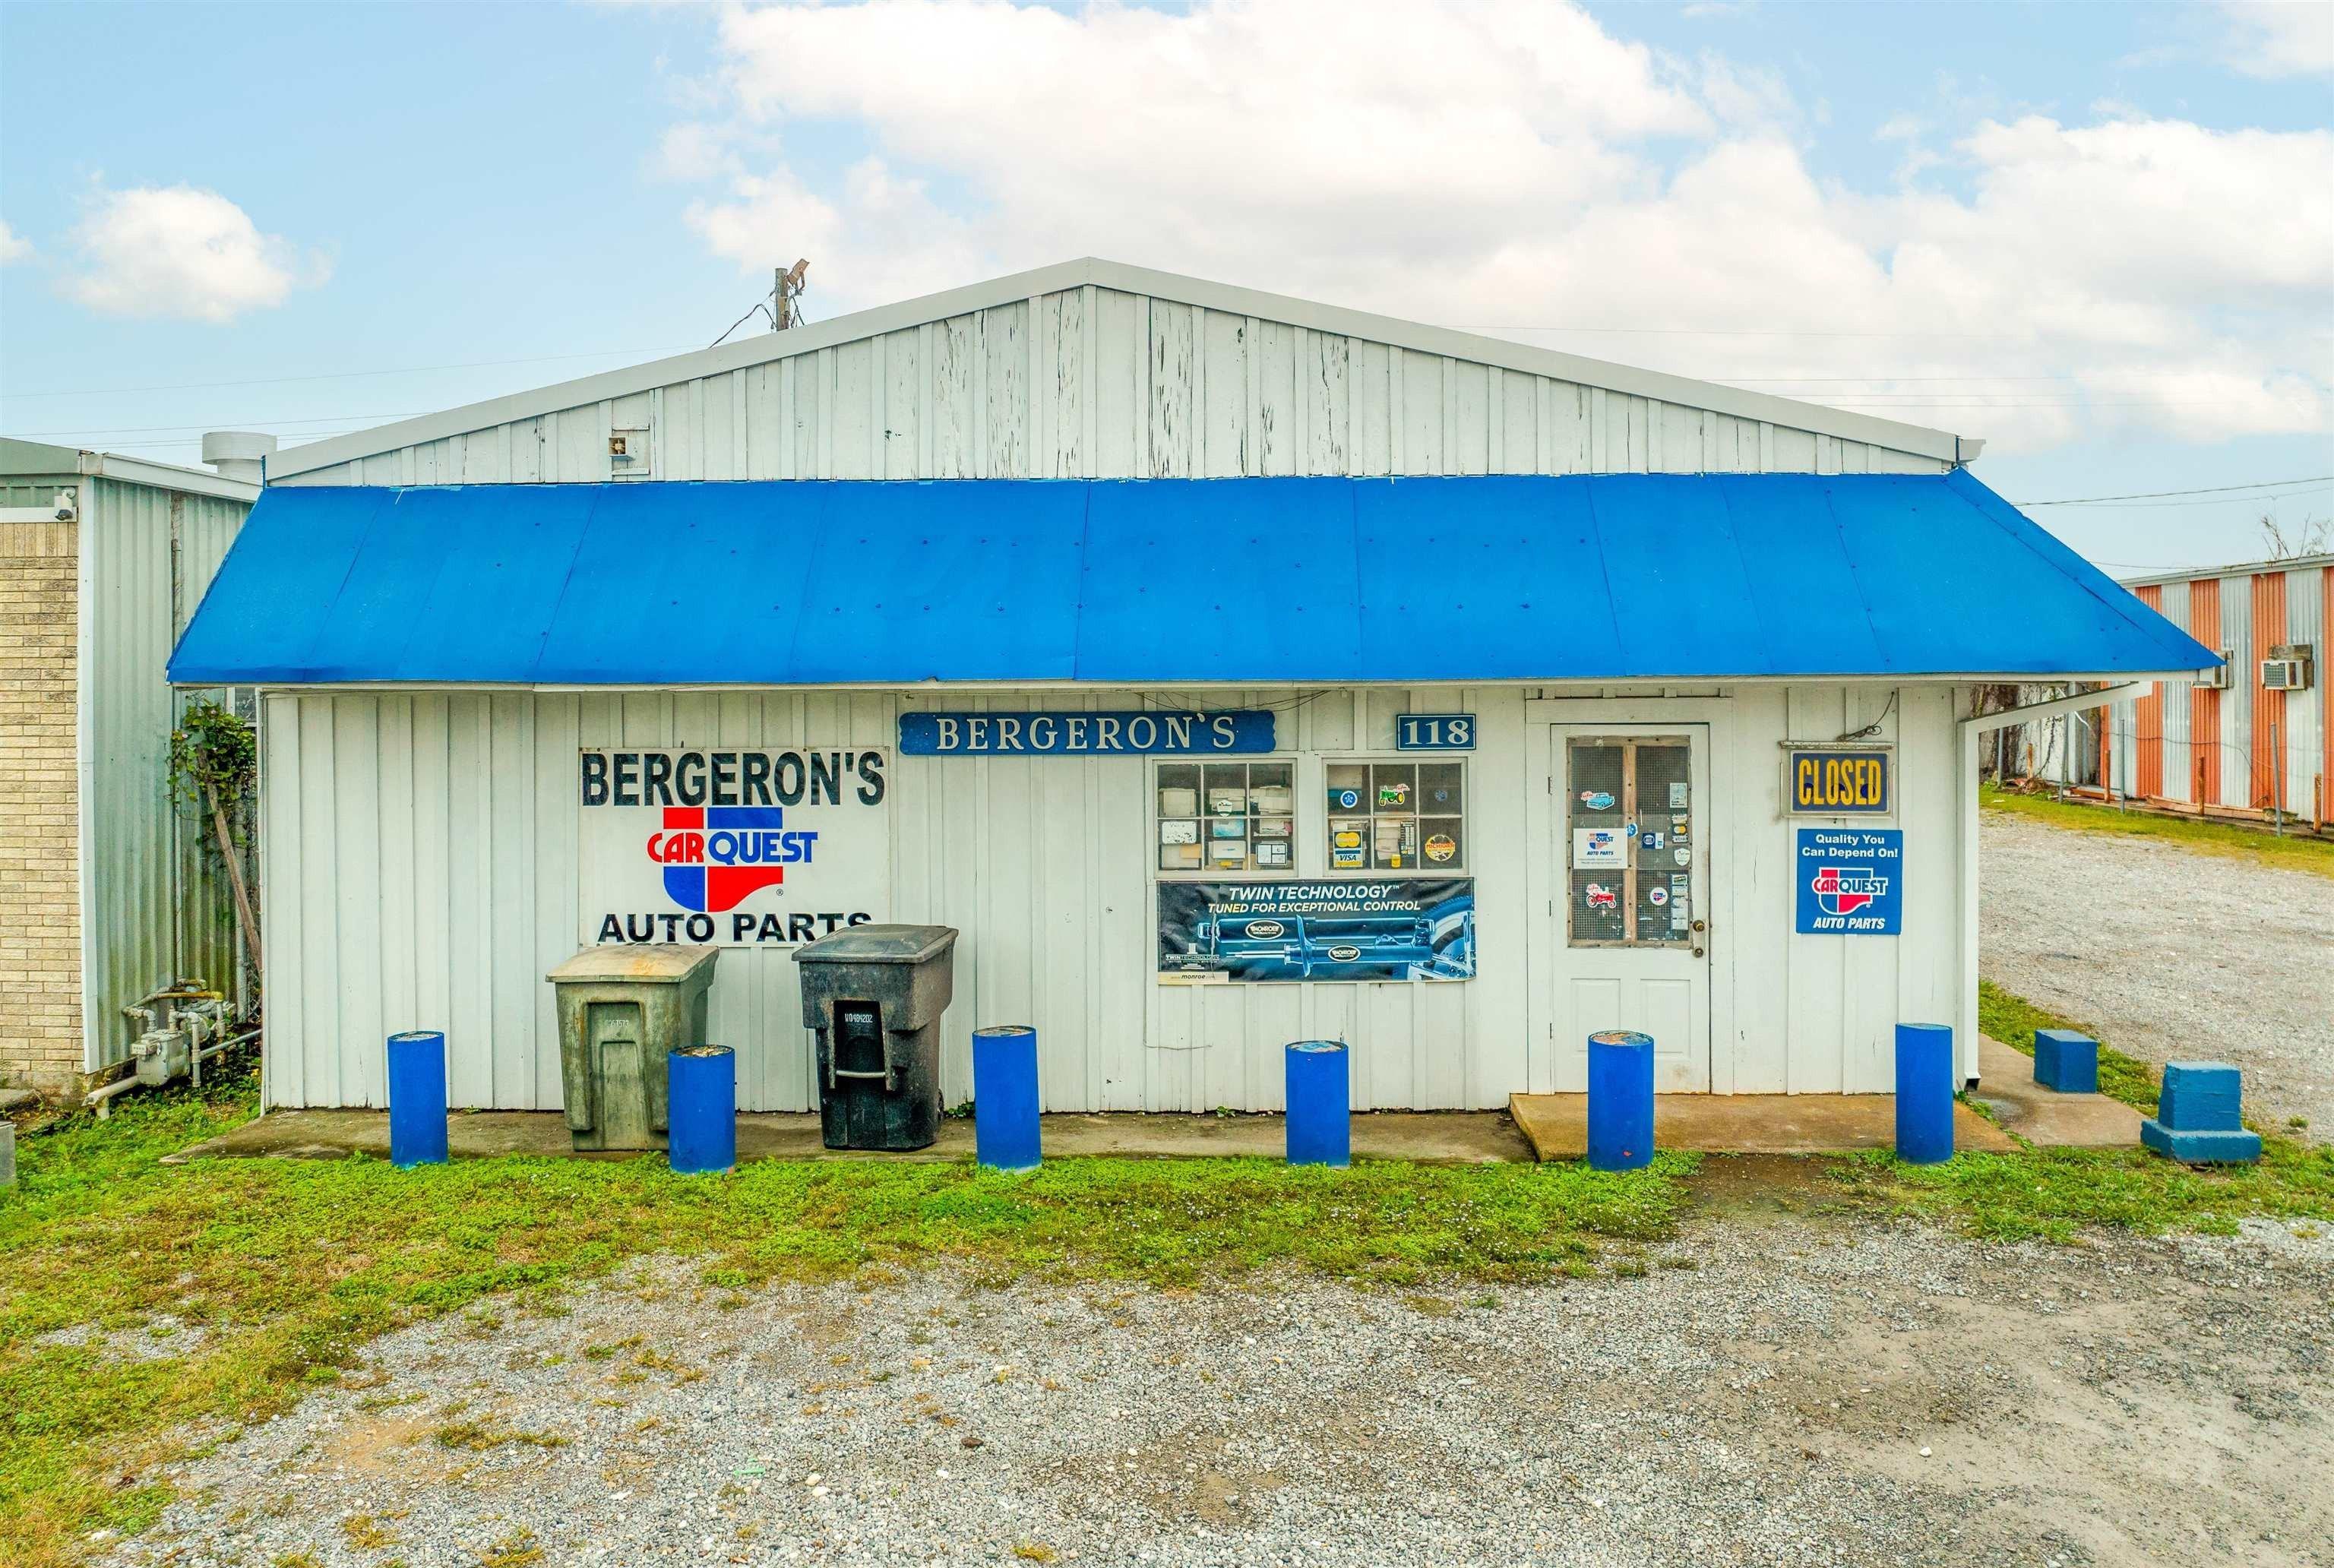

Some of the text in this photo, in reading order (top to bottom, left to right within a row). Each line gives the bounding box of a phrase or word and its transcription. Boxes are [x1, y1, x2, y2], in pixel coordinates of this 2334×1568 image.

[936, 712, 1236, 751] BERGERON'S
[1404, 719, 1470, 745] 118
[581, 751, 886, 807] BERGERON'S
[1798, 759, 1881, 805] CLOSED
[647, 831, 819, 866] CARQUEST
[1815, 834, 1885, 846] Quality You
[1801, 847, 1898, 859] Can Depend On!
[1229, 887, 1275, 901] TWIN
[1813, 878, 1886, 893] CARQUEST
[1208, 900, 1422, 913] TUNED FOR EXCEPTIONAL CONTROL
[597, 912, 716, 943] AUTO
[1813, 917, 1886, 929] AUTO PARTS
